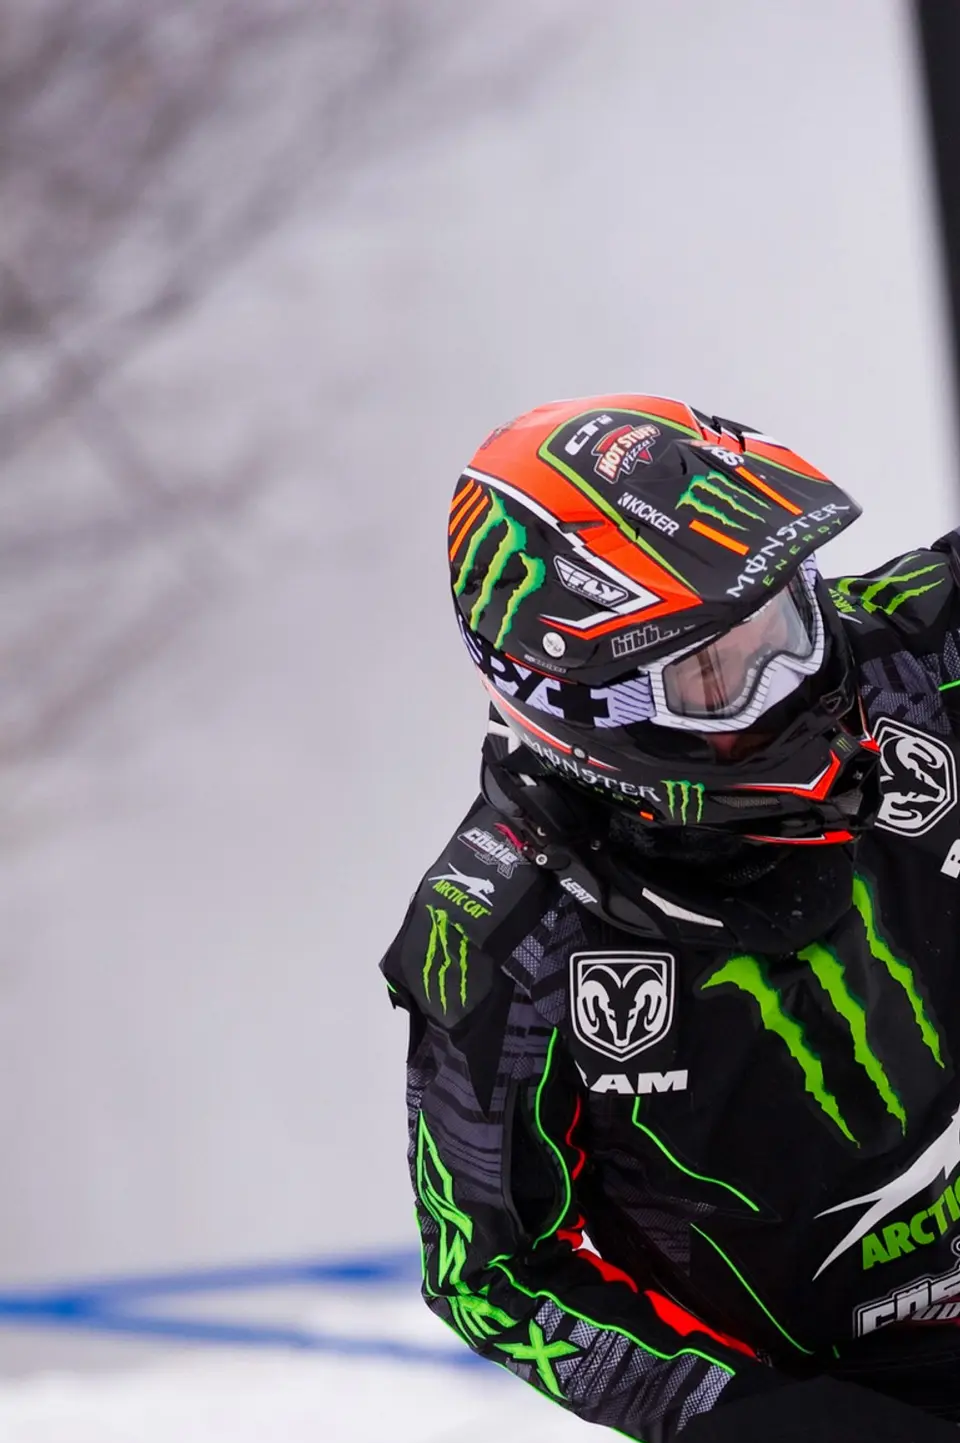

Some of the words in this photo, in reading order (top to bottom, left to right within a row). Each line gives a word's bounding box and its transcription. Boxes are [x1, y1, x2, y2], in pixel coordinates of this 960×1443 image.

[600, 437, 626, 479] HOT
[623, 424, 659, 449] STUFF
[621, 439, 650, 471] Pizza
[628, 497, 680, 537] KICKER
[726, 503, 850, 598] MONSTER
[762, 518, 843, 587] ENERGY
[432, 879, 469, 906] ARCTIC
[463, 900, 489, 919] CAT
[574, 1060, 688, 1095] AM
